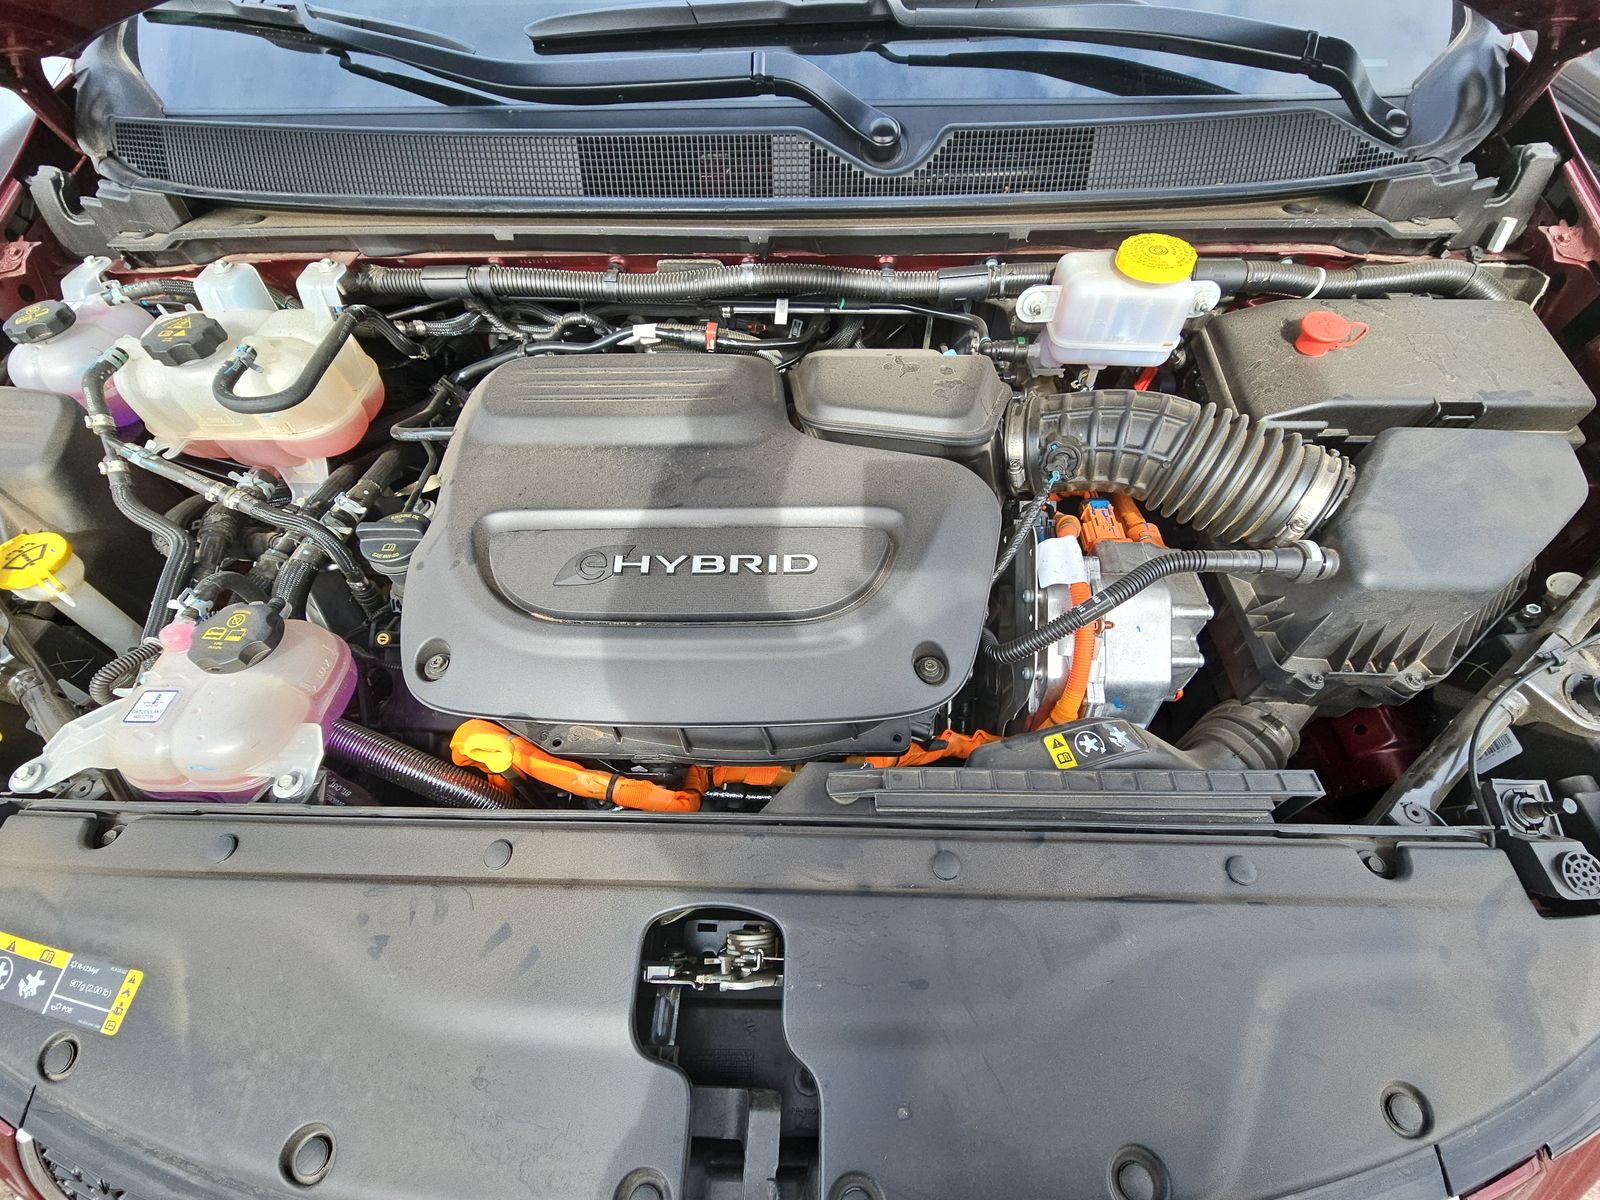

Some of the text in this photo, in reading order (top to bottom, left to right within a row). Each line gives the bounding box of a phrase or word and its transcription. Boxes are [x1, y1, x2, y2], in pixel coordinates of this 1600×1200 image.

[69, 979, 112, 999] 907g (2.00 lb)
[61, 1005, 74, 1014] POE
